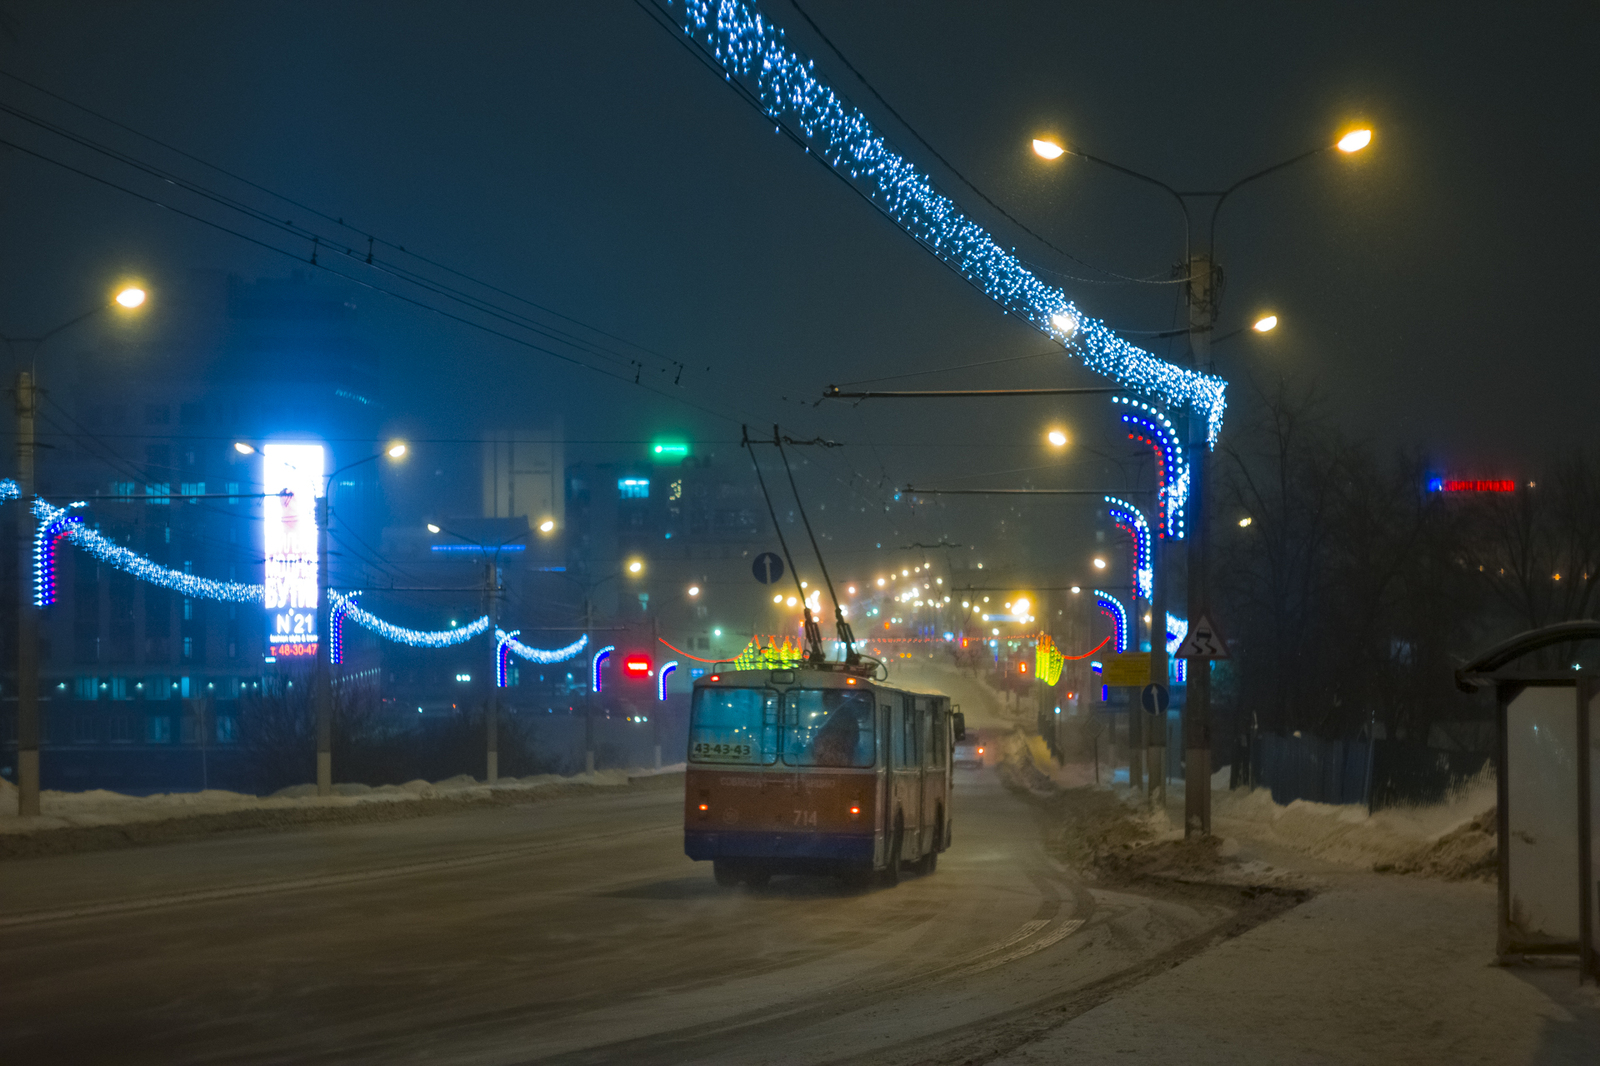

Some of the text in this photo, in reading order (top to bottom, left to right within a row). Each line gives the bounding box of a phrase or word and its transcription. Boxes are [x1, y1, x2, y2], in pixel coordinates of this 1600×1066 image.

[279, 644, 319, 656] 48-30-47
[695, 743, 751, 755] 43-43-43
[794, 810, 817, 826] 714
